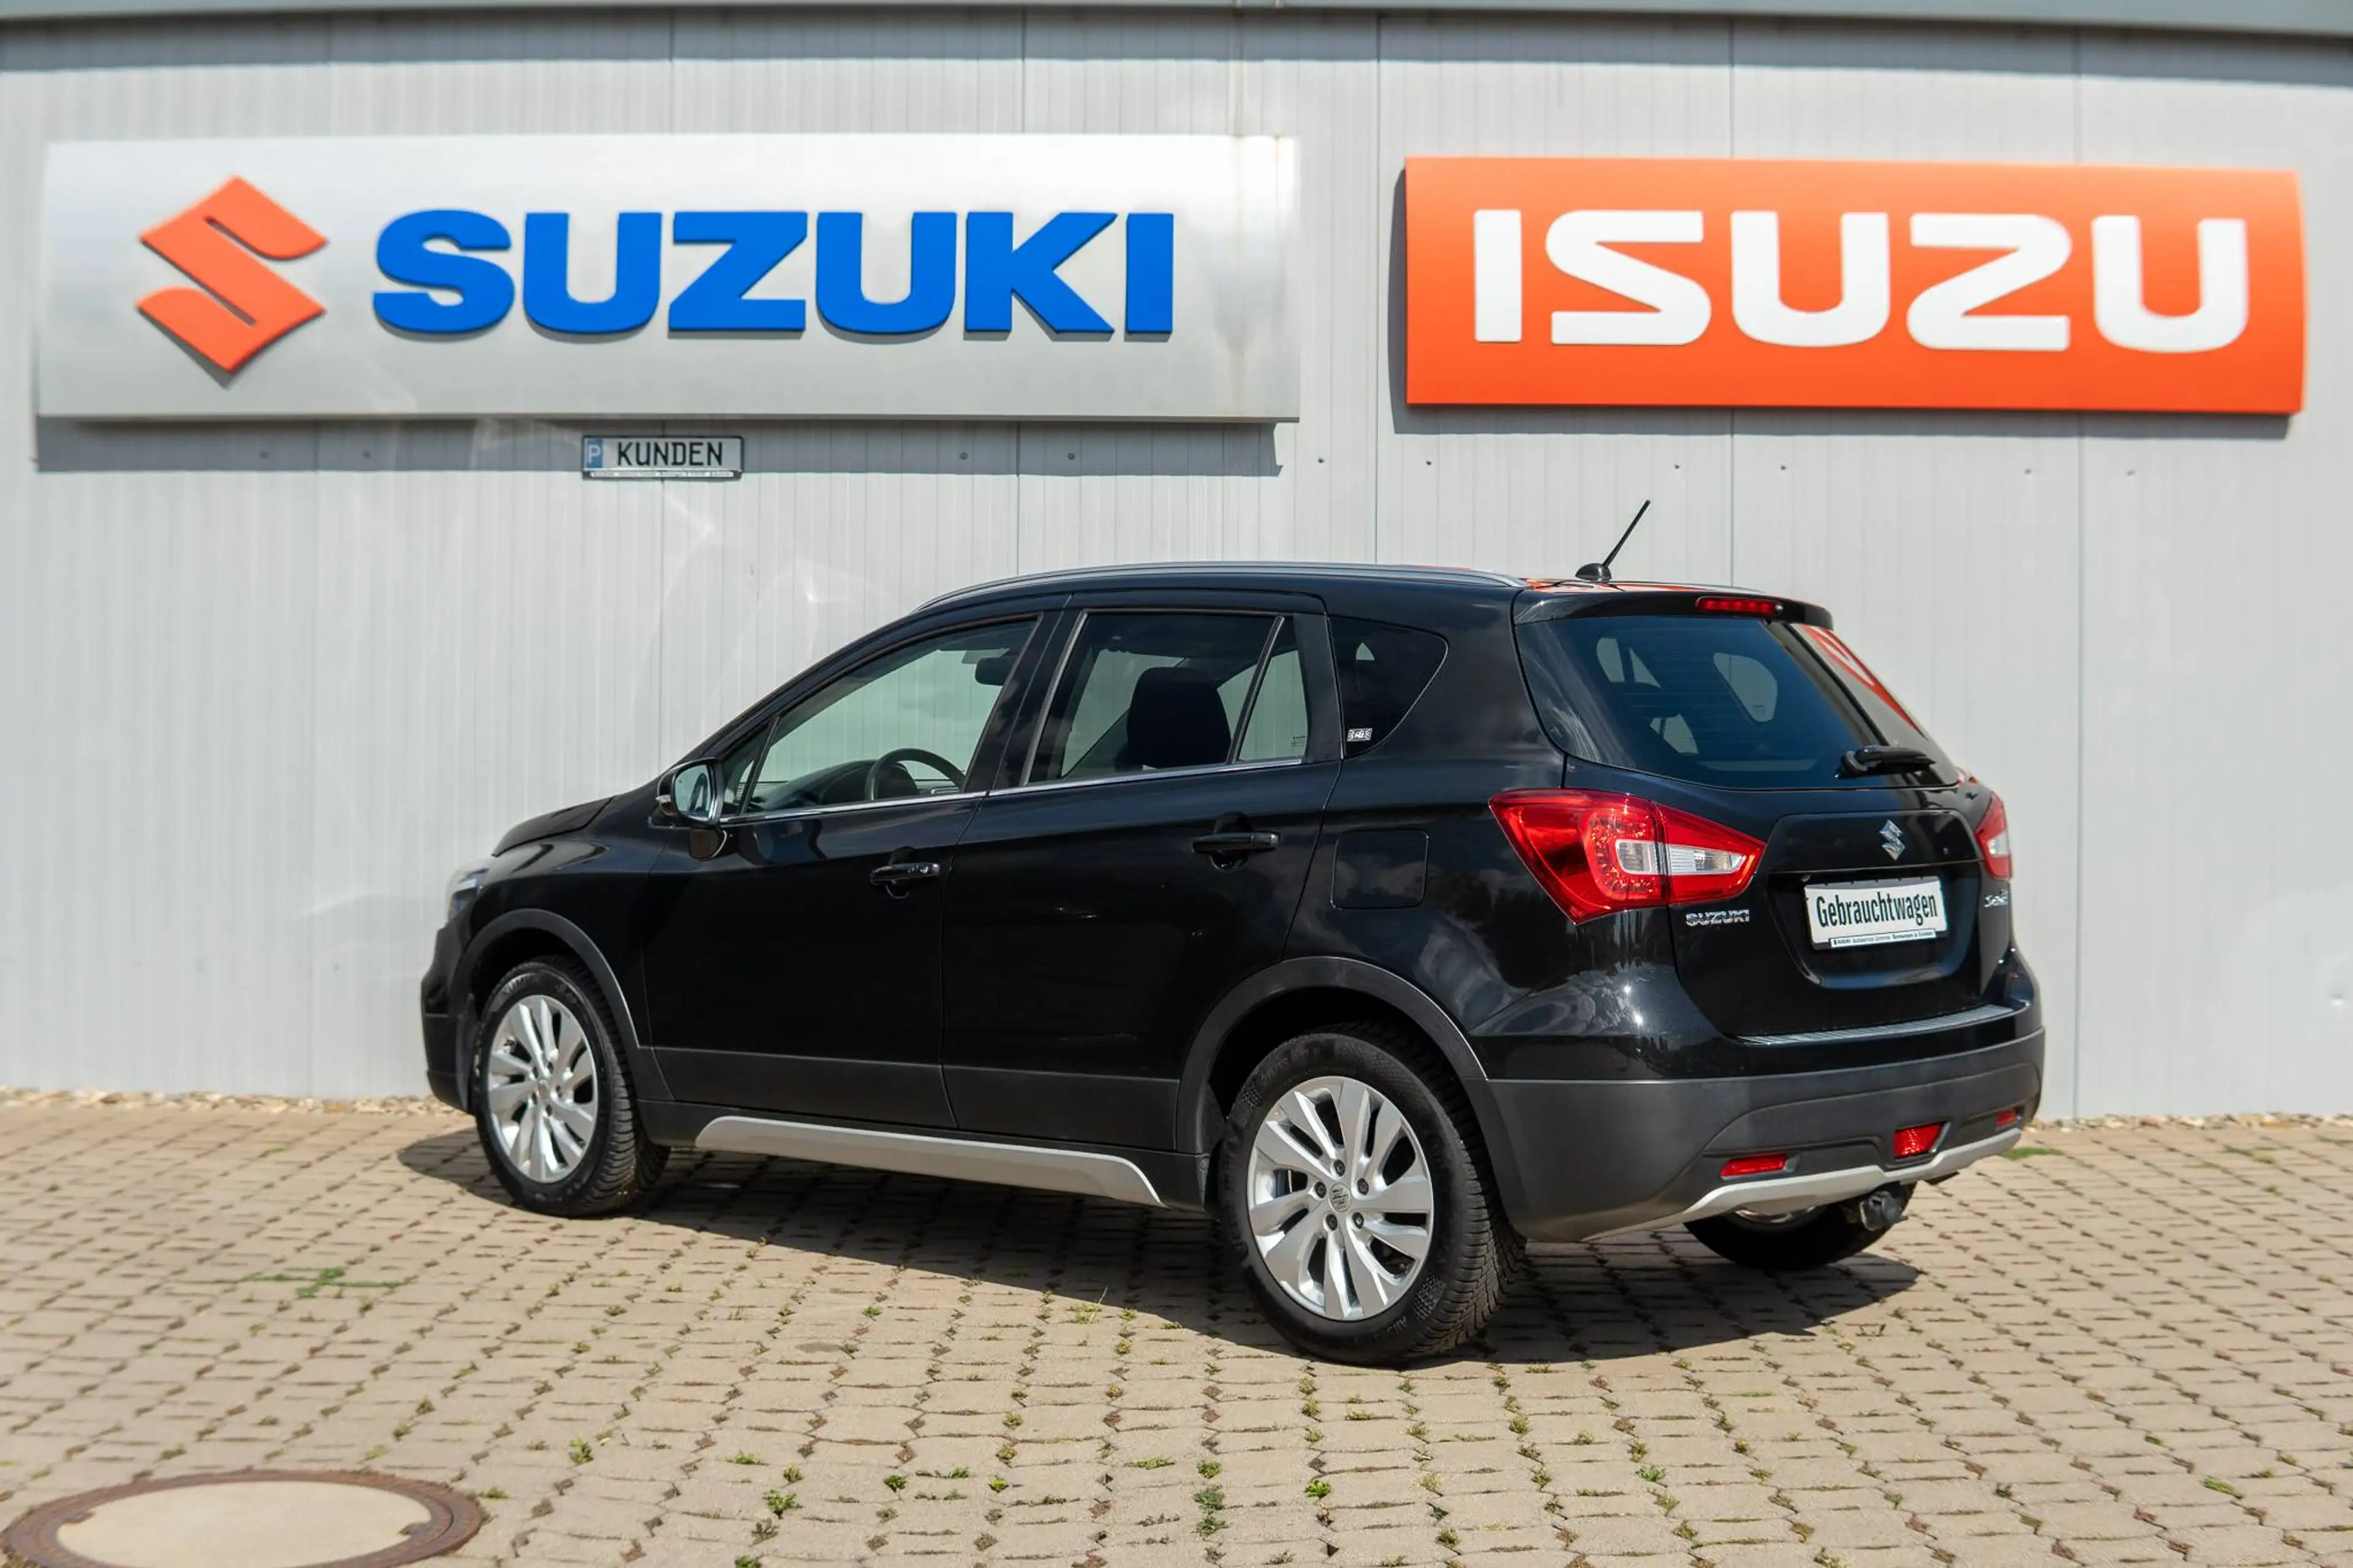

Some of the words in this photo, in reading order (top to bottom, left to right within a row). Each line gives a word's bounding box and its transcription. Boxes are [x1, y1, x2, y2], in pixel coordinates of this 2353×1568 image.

[373, 209, 1174, 334] SUZUKI
[1473, 209, 2248, 353] ISUZU
[617, 441, 723, 466] KUNDEN
[1686, 909, 1750, 926] SUZUKI
[1816, 891, 1938, 928] Gebrauchtwagen
